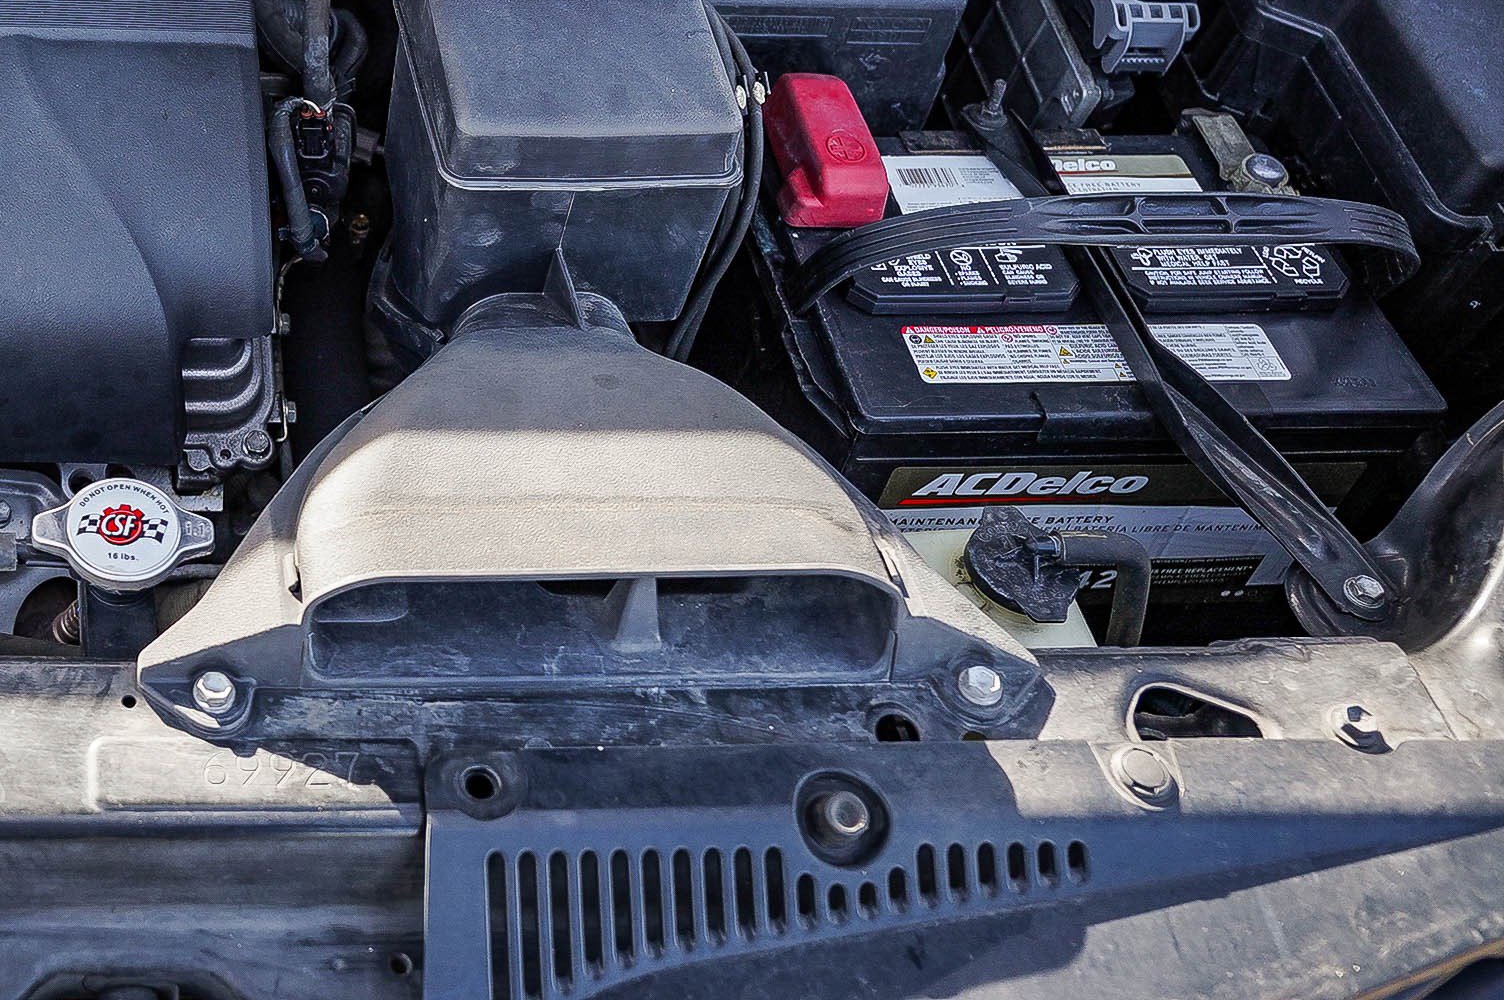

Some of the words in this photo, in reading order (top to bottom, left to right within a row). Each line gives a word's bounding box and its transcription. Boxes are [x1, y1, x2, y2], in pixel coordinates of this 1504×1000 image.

[1051, 158, 1117, 172] Delco
[911, 470, 1150, 497] ACDelco
[79, 497, 90, 507] DO
[89, 487, 105, 500] NOT
[132, 485, 157, 502] WHEN
[156, 499, 170, 514] HOT
[101, 514, 136, 537] CSF
[890, 517, 984, 526] MAINTENAN
[1045, 515, 1115, 525] BATTERY
[1131, 523, 1168, 533] LIBRE
[1173, 523, 1191, 533] DE
[107, 552, 118, 560] 16
[120, 552, 139, 561] lbs.
[203, 751, 361, 787] 69927
